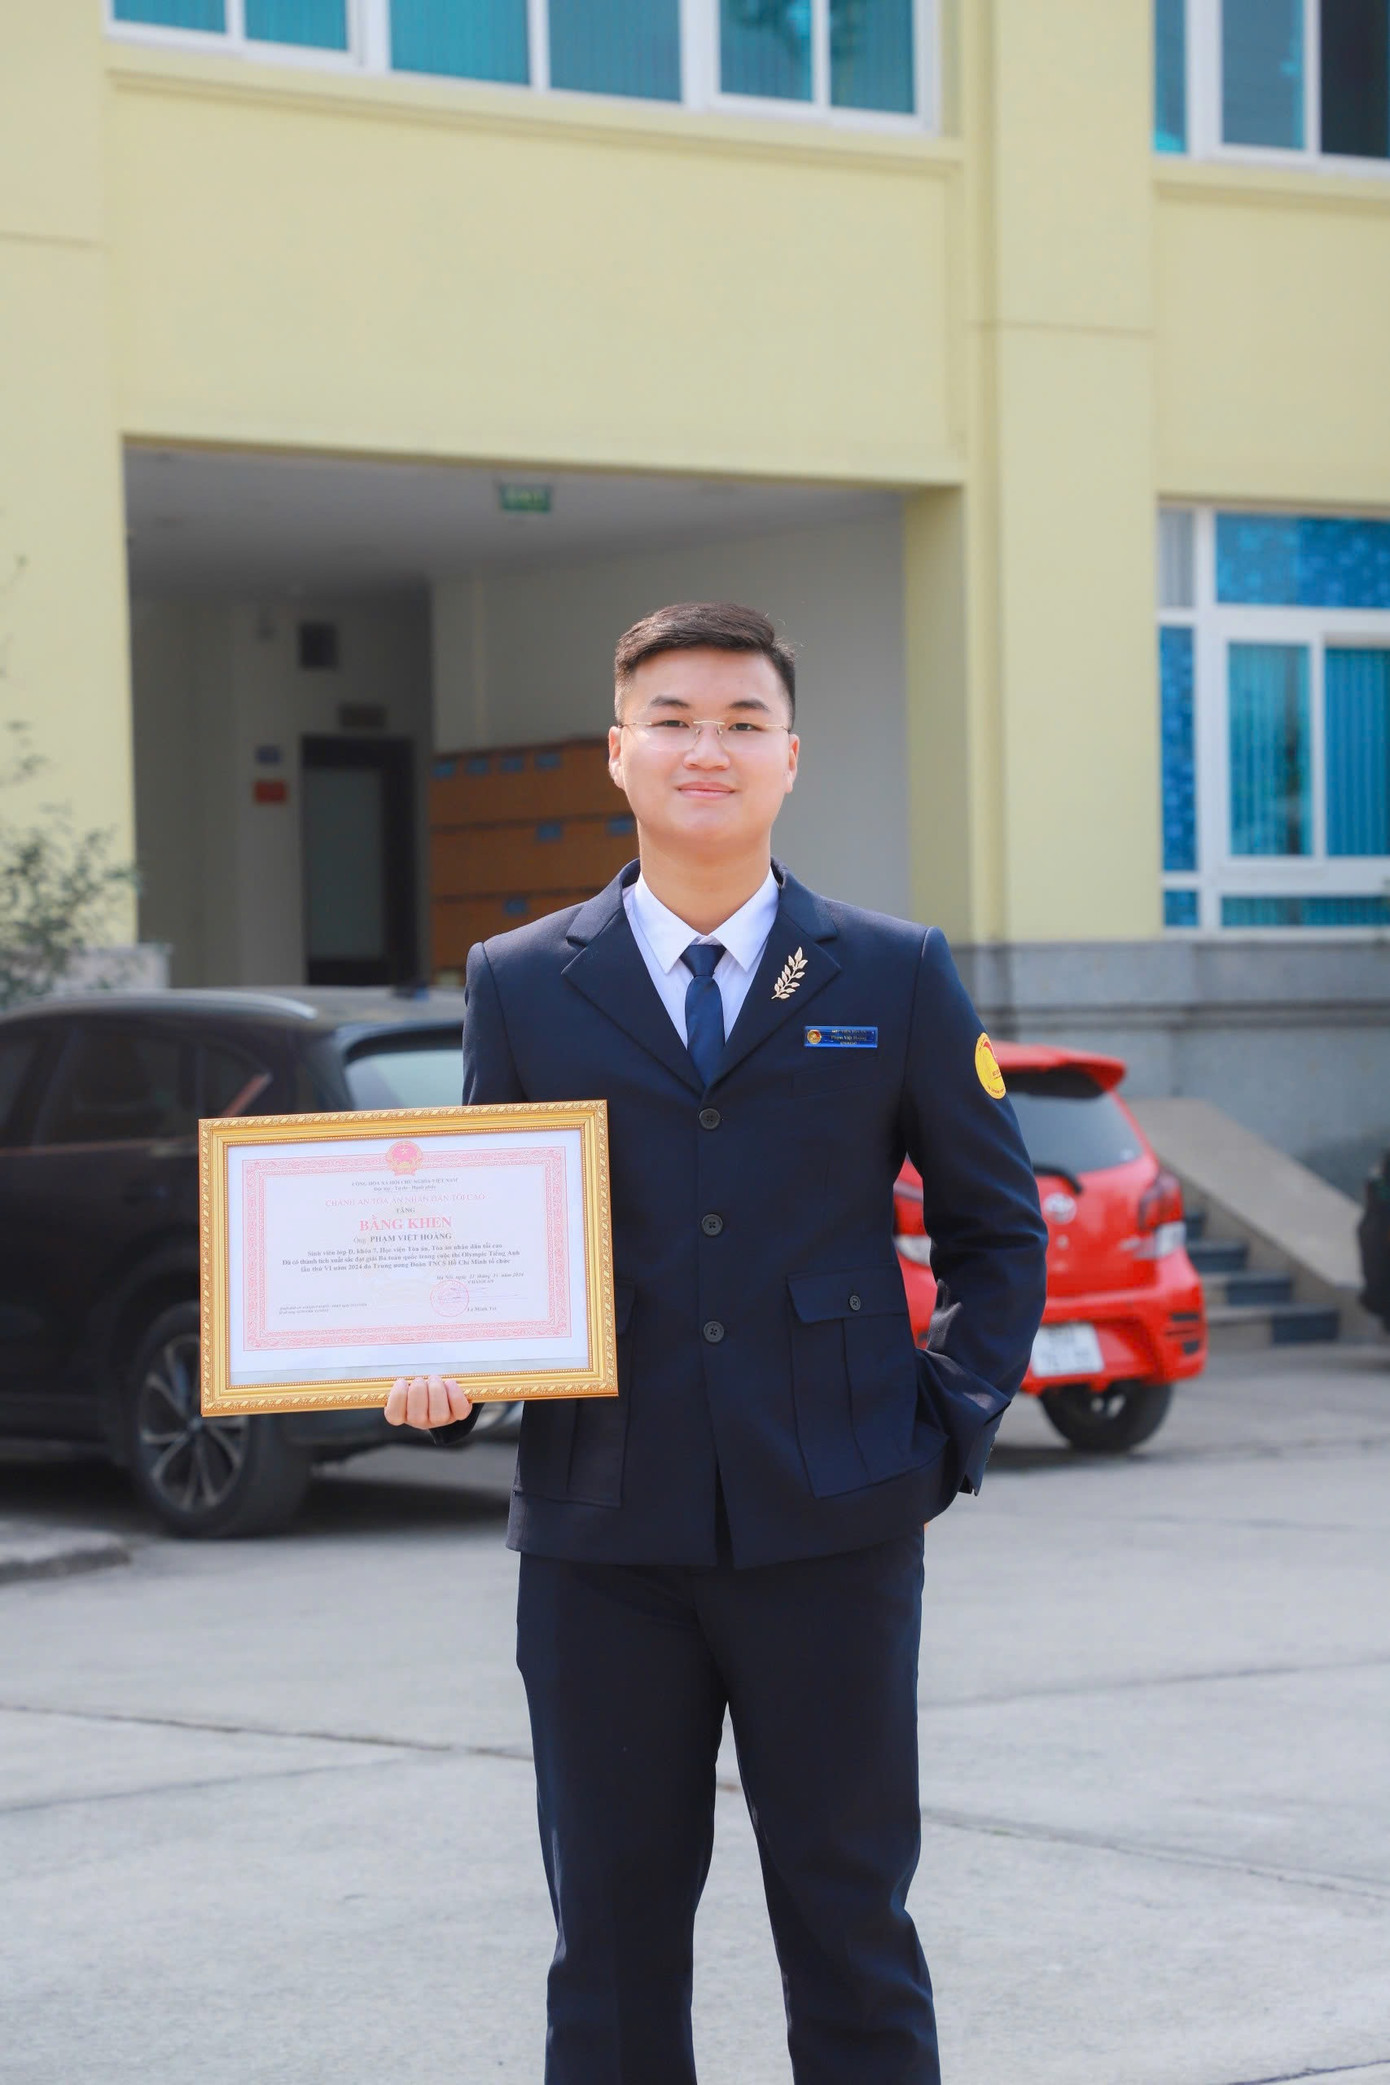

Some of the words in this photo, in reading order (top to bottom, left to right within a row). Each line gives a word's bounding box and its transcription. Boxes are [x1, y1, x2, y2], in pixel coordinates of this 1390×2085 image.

[360, 1214, 403, 1231] BẰNG
[408, 1216, 452, 1229] KHEN
[370, 1235, 396, 1243] PHẠM
[398, 1234, 418, 1242] VIỆT
